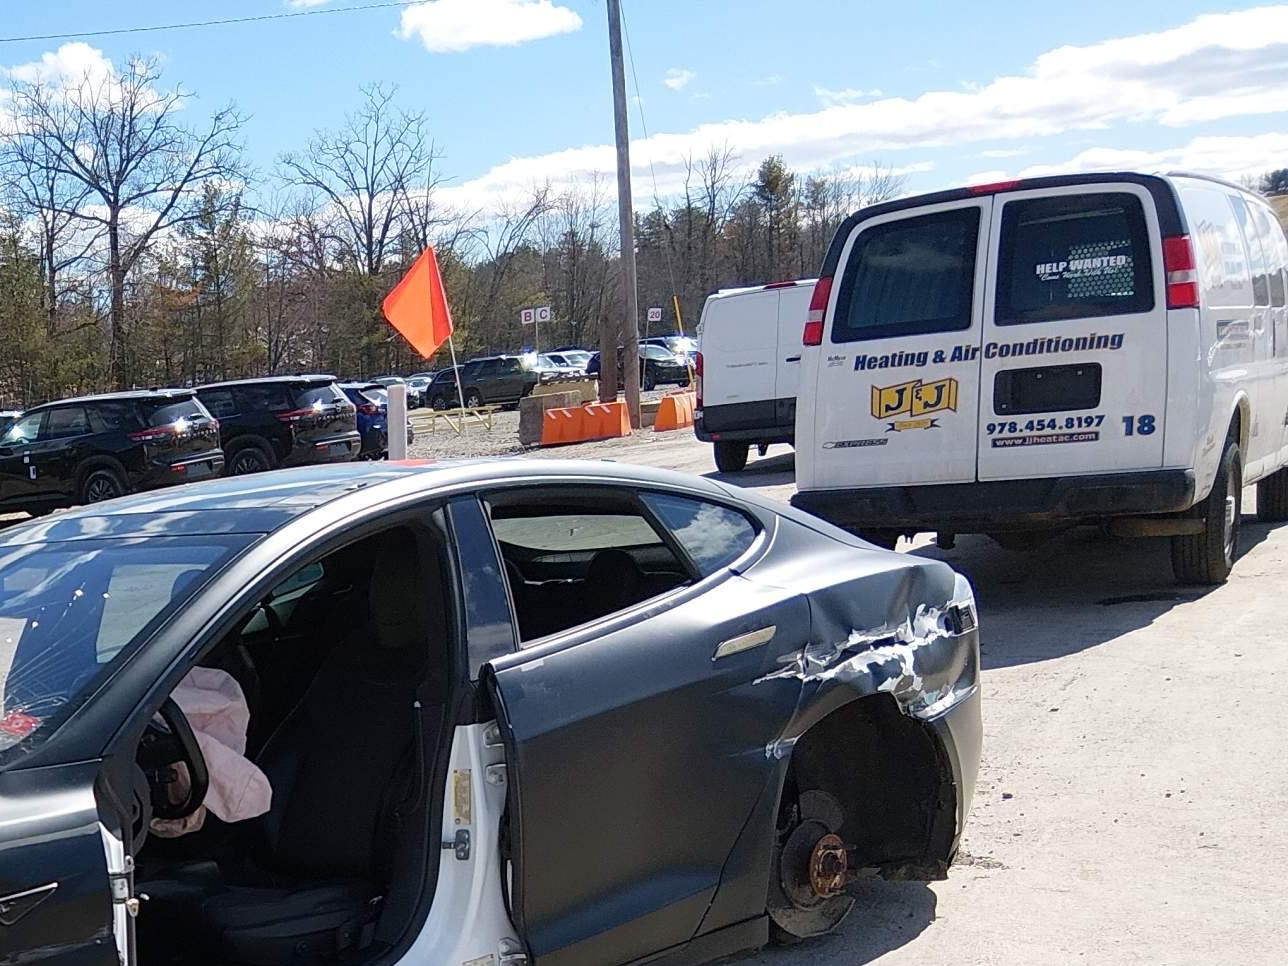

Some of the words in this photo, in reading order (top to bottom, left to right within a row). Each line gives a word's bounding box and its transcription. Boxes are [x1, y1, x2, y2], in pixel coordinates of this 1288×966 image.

[1036, 262, 1067, 274] HELP
[1069, 255, 1126, 270] WANTED
[524, 311, 532, 322] B
[539, 309, 548, 319] C
[649, 310, 661, 320] 20
[854, 351, 929, 371] Heating
[932, 350, 946, 364] &
[950, 345, 981, 362] Air
[984, 333, 1125, 359] Conditioning
[885, 387, 907, 413] J
[923, 384, 946, 409] J
[986, 415, 1105, 435] 978.454.8197
[1122, 414, 1156, 436] 18
[994, 432, 1097, 446] www.jjheatac.com
